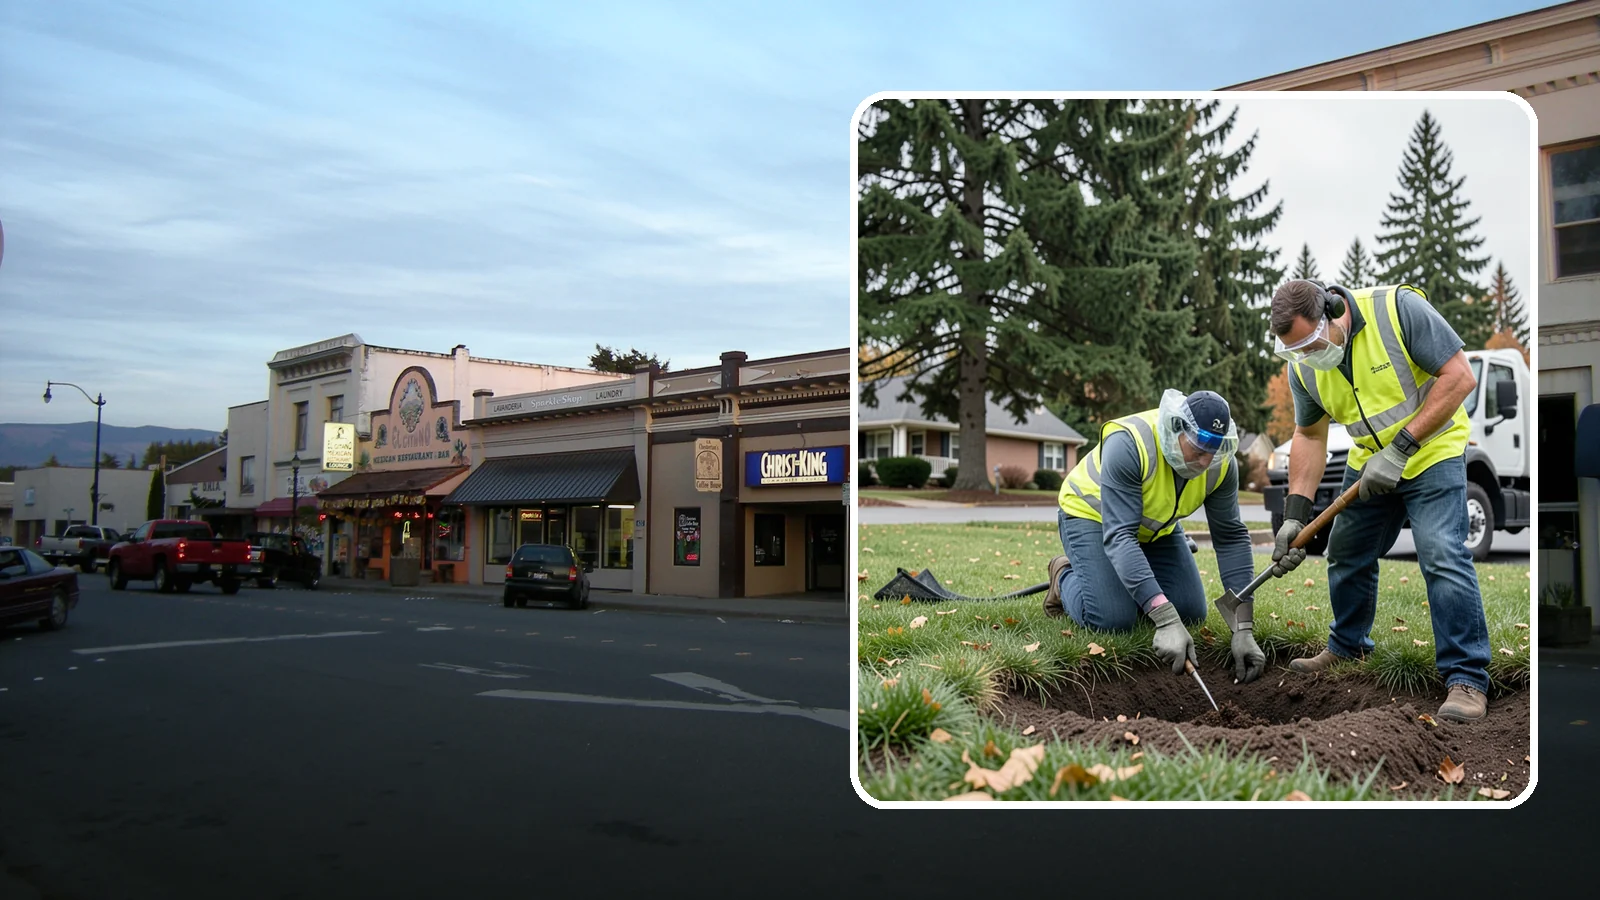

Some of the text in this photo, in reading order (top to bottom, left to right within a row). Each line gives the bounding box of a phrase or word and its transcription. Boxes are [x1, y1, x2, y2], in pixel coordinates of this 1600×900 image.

[595, 389, 623, 399] LAUNDRY
[493, 402, 522, 413] LAVANDERIA
[531, 394, 582, 409] Sparkle Shop
[374, 455, 396, 464] MEXICAN
[397, 451, 433, 463] RESTAURANT
[437, 450, 450, 459] BAR
[761, 450, 827, 478] CHRIST KING
